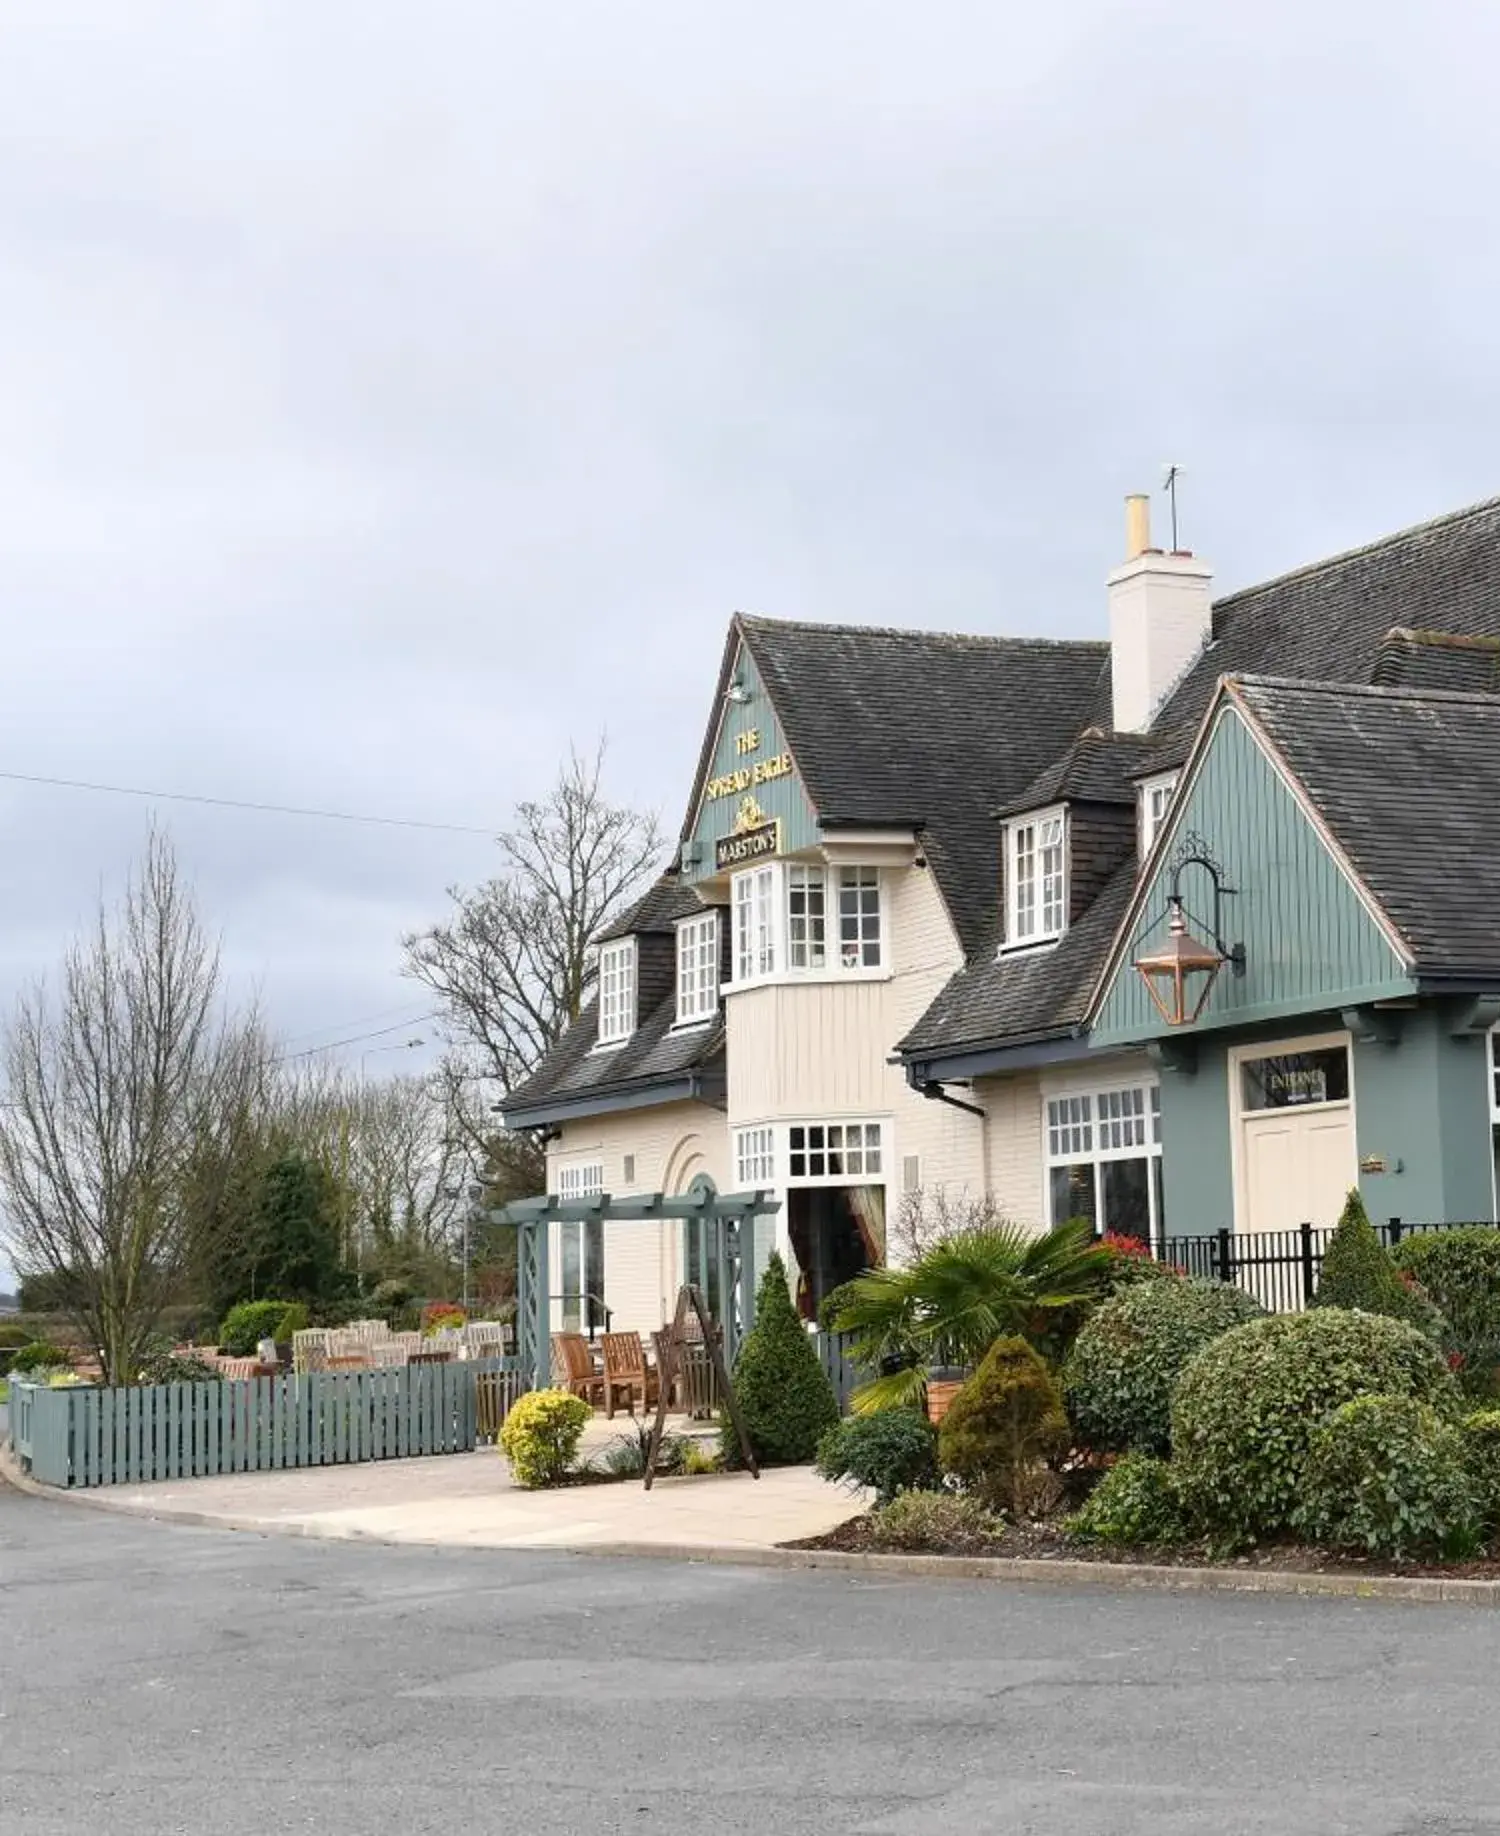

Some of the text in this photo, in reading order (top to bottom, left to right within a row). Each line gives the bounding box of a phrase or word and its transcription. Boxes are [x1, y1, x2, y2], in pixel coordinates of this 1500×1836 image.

[734, 728, 760, 755] THE
[708, 752, 792, 799] SPREAD EAGLE
[719, 831, 775, 862] MARSTON'S
